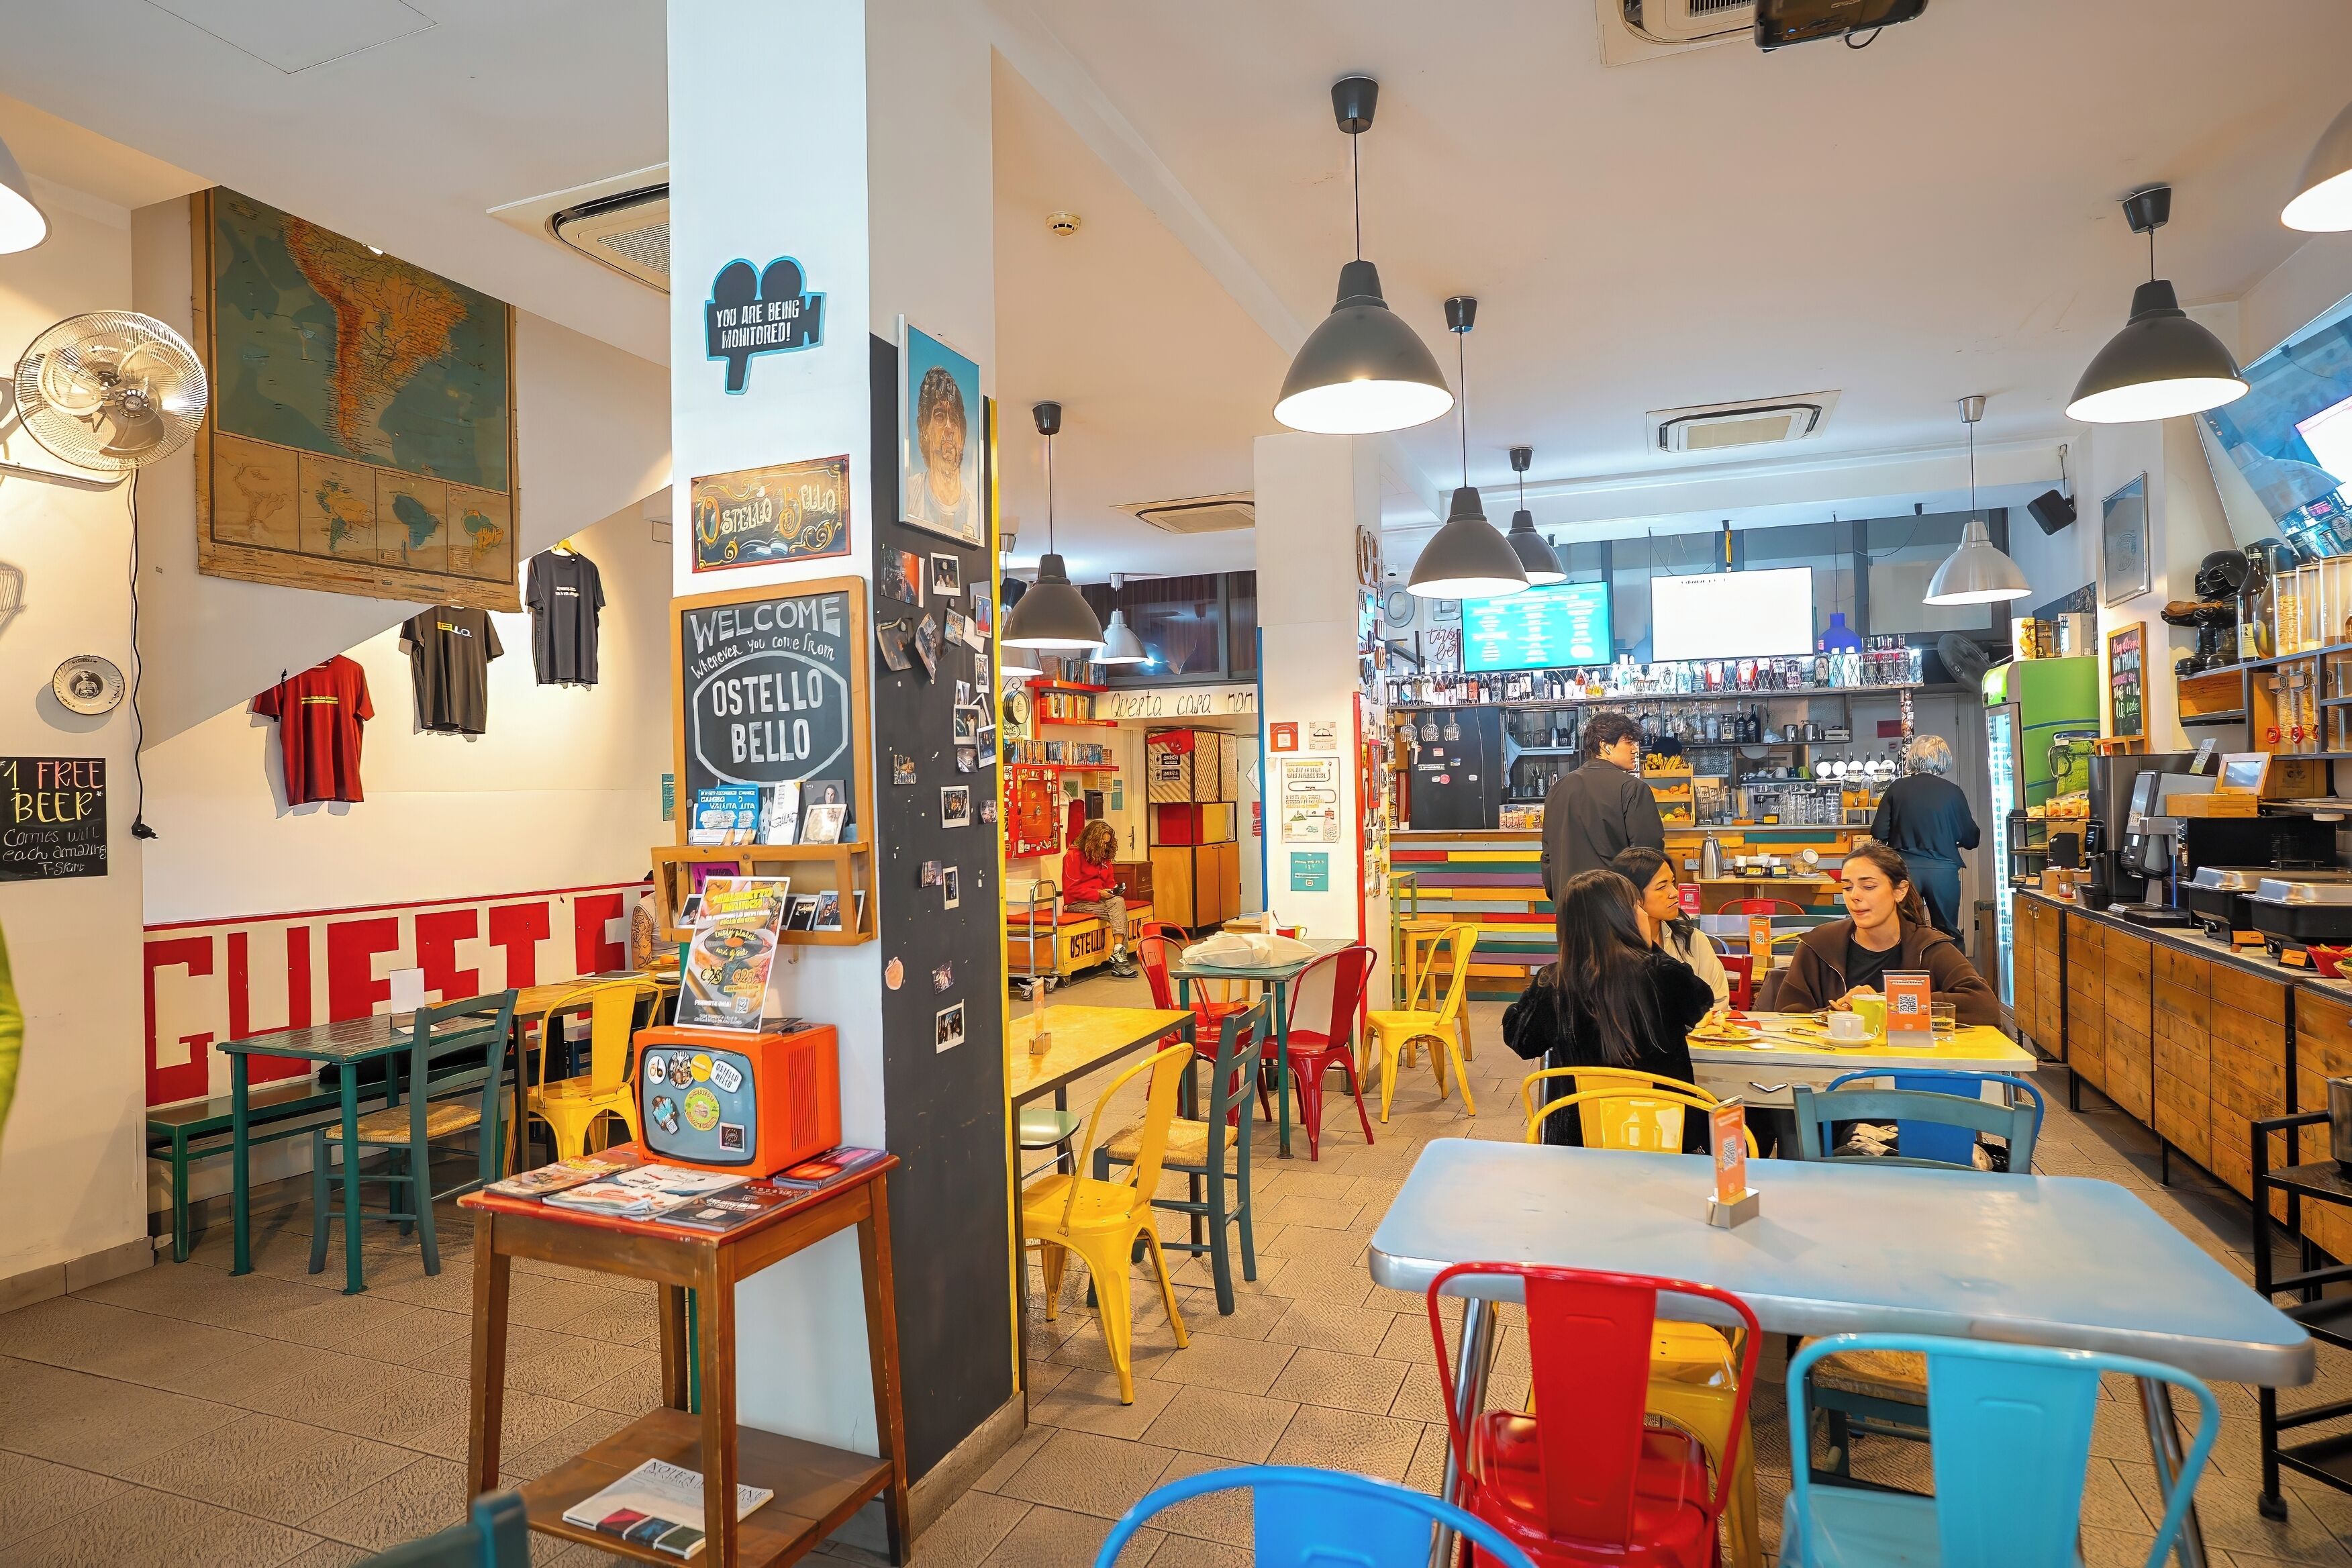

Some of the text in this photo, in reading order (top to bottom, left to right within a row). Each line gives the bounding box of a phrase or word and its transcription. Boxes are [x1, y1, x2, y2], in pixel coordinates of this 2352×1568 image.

[716, 299, 799, 328] YOU ARE BEING
[722, 322, 791, 350] MONITORED!
[690, 596, 841, 654] WELCOME
[747, 638, 765, 654] you
[772, 636, 799, 651] come
[712, 668, 824, 718] OSTELLO
[731, 718, 811, 764] BELLO
[37, 761, 103, 789] FREE
[3, 846, 48, 862] each
